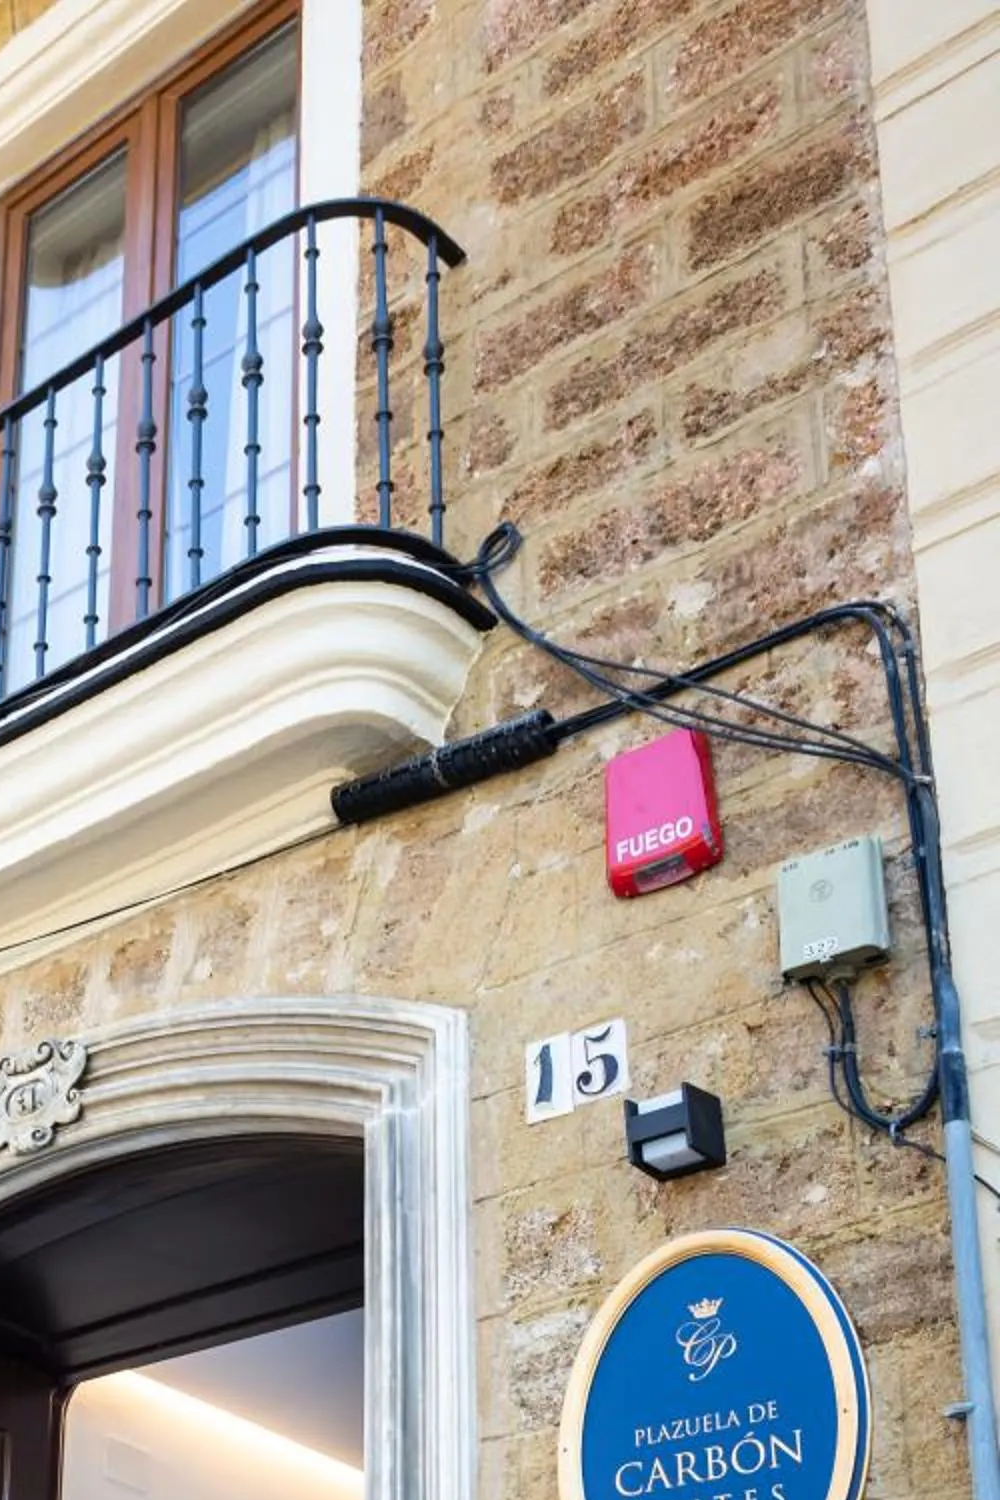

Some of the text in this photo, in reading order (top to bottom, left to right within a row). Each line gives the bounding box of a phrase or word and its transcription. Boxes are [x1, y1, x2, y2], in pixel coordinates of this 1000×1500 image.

[616, 816, 693, 863] FUEGO
[534, 1025, 619, 1106] 15
[635, 1400, 778, 1447] PLAZUELA DE
[615, 1429, 802, 1497] CARBÓN
